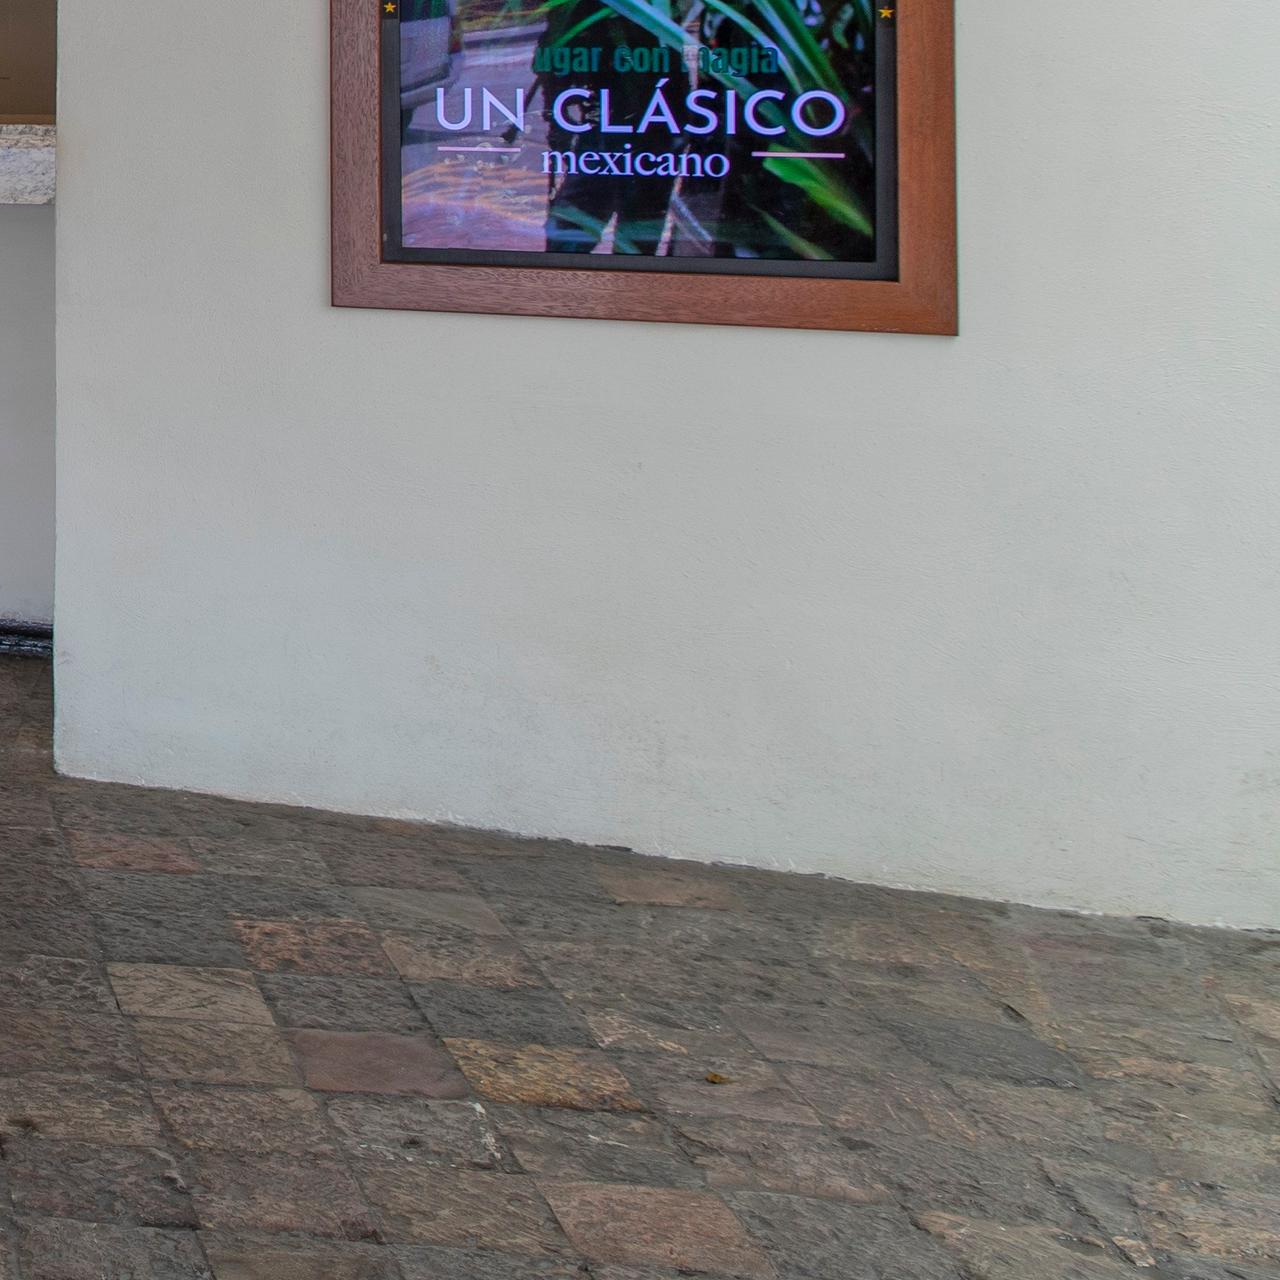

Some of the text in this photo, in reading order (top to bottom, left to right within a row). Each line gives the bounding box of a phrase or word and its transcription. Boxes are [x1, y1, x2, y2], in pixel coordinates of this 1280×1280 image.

[613, 45, 670, 73] con
[437, 78, 846, 137] UN CLÁSICO
[542, 143, 730, 178] mexicano
